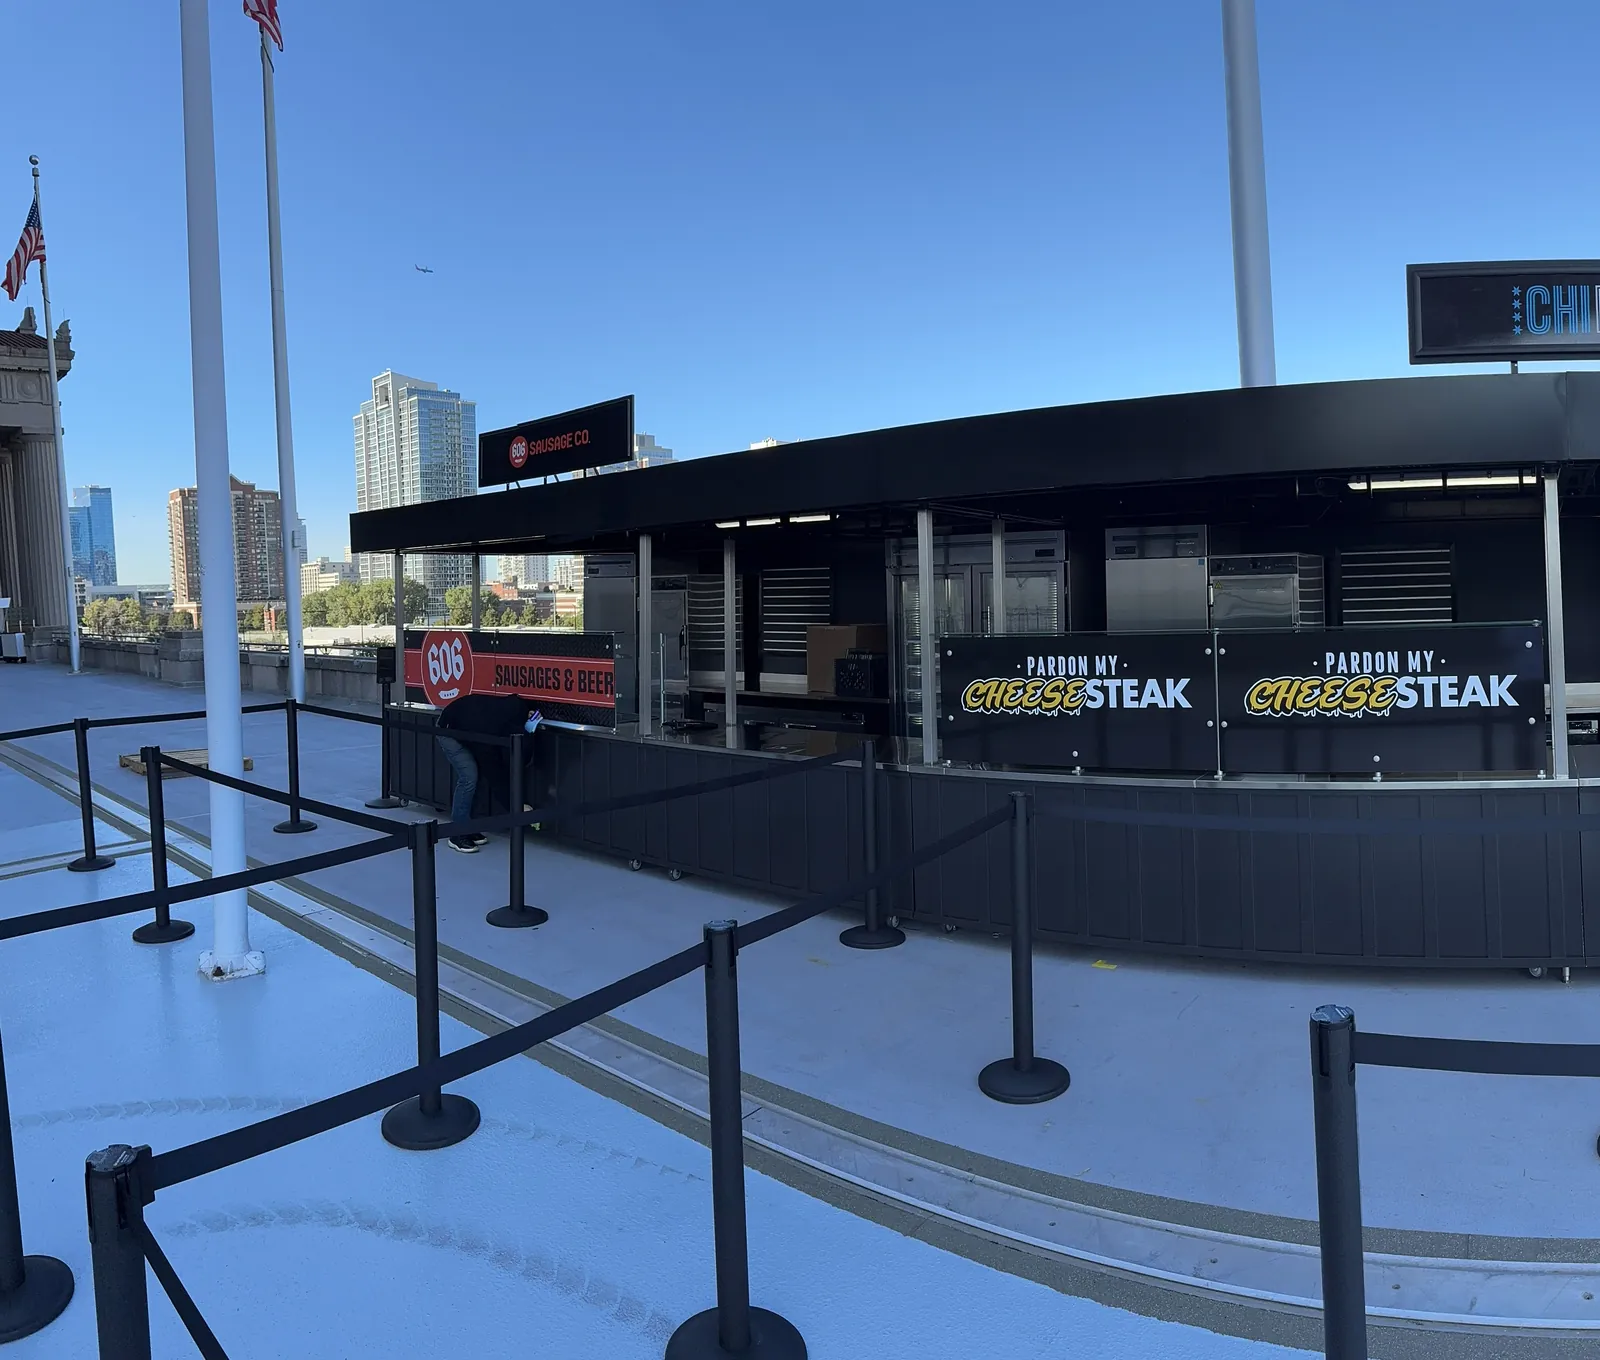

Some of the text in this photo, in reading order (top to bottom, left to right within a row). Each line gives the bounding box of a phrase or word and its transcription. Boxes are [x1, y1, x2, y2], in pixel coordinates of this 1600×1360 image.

[511, 429, 591, 458] 606 SAUSAGE CO.
[427, 636, 465, 686] 606
[1027, 655, 1118, 676] PARDON MY
[1325, 650, 1434, 674] PARDON MY
[495, 664, 614, 695] SAUSAGES & BEER
